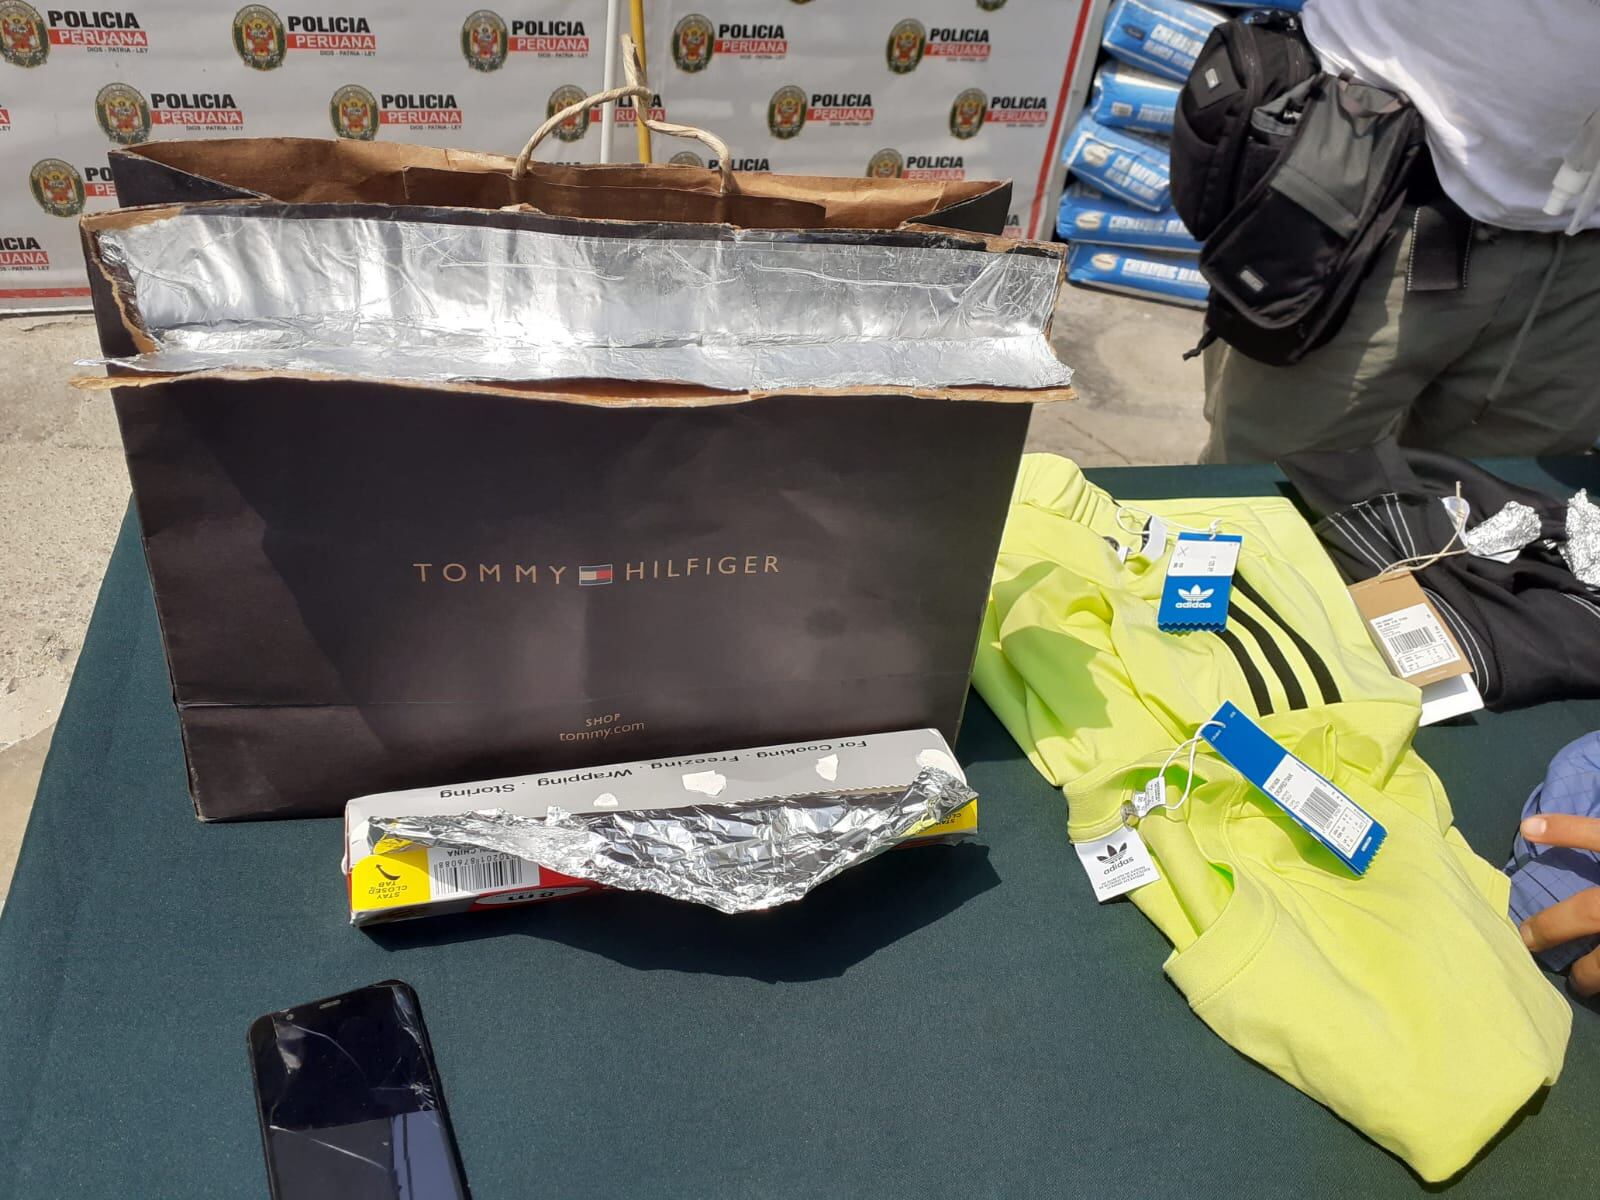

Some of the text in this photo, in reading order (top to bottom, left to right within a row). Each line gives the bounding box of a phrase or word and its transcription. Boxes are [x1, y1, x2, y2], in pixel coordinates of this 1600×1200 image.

[47, 10, 140, 28] POLICIA
[287, 16, 370, 33] POLICIA
[512, 20, 585, 36] POLICIA
[718, 24, 785, 39] POLICIA
[59, 30, 147, 45] PERUANA
[295, 35, 375, 48] PERUANA
[929, 28, 989, 43] POLICIA
[517, 38, 587, 50] PERUANA
[722, 41, 785, 52] PERUANA
[931, 44, 988, 56] PERUANA
[151, 93, 236, 109] POLICIA
[381, 94, 457, 109] POLICIA
[811, 94, 872, 107] POLICIA
[991, 96, 1047, 109] POLICIA
[160, 111, 241, 123] PERUANA
[388, 111, 460, 123] PERUANA
[813, 109, 872, 120] PERUANA
[991, 111, 1046, 121] PERUANA
[708, 158, 769, 171] PLICIA
[907, 156, 964, 168] POLICIA
[412, 555, 781, 584] TOMMY HILFIGER
[1175, 601, 1212, 609] adidas
[585, 713, 621, 727] SHOP
[560, 722, 645, 741] tommy.com
[440, 740, 867, 798] For Cooking Freezing Wrapping Storing
[447, 849, 477, 857] CHINA
[1103, 856, 1134, 875] adidas
[368, 885, 408, 894] CLOSED
